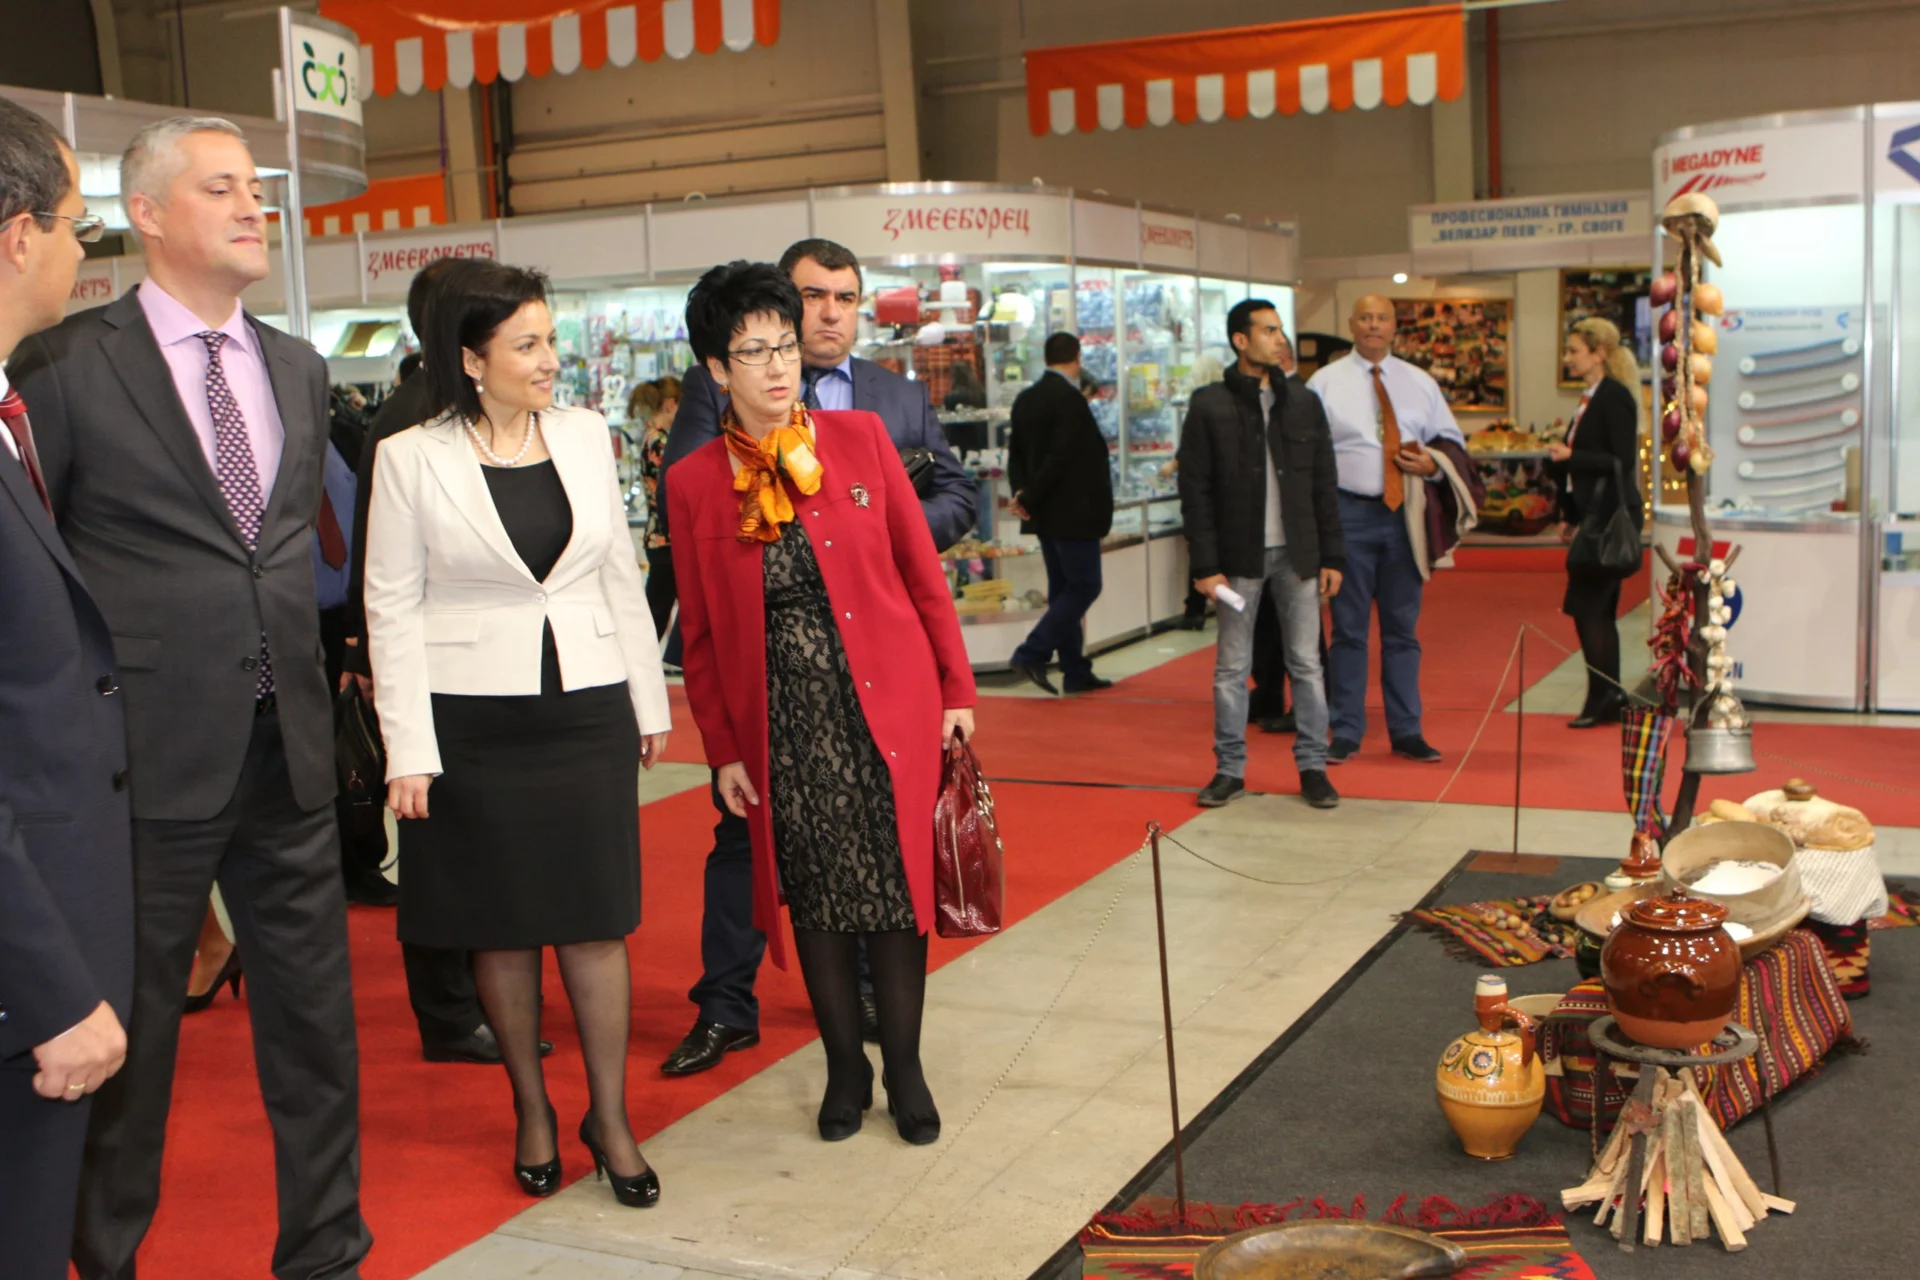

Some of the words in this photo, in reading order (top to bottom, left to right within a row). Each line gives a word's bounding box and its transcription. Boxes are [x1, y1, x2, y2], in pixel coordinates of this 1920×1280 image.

[1672, 143, 1764, 174] MEGADYNE
[1431, 205, 1549, 225] ПРОФЕСИОНАЛНА
[1553, 200, 1629, 217] ГИМНАЗИЯ
[1582, 219, 1624, 234] СВОГЕ
